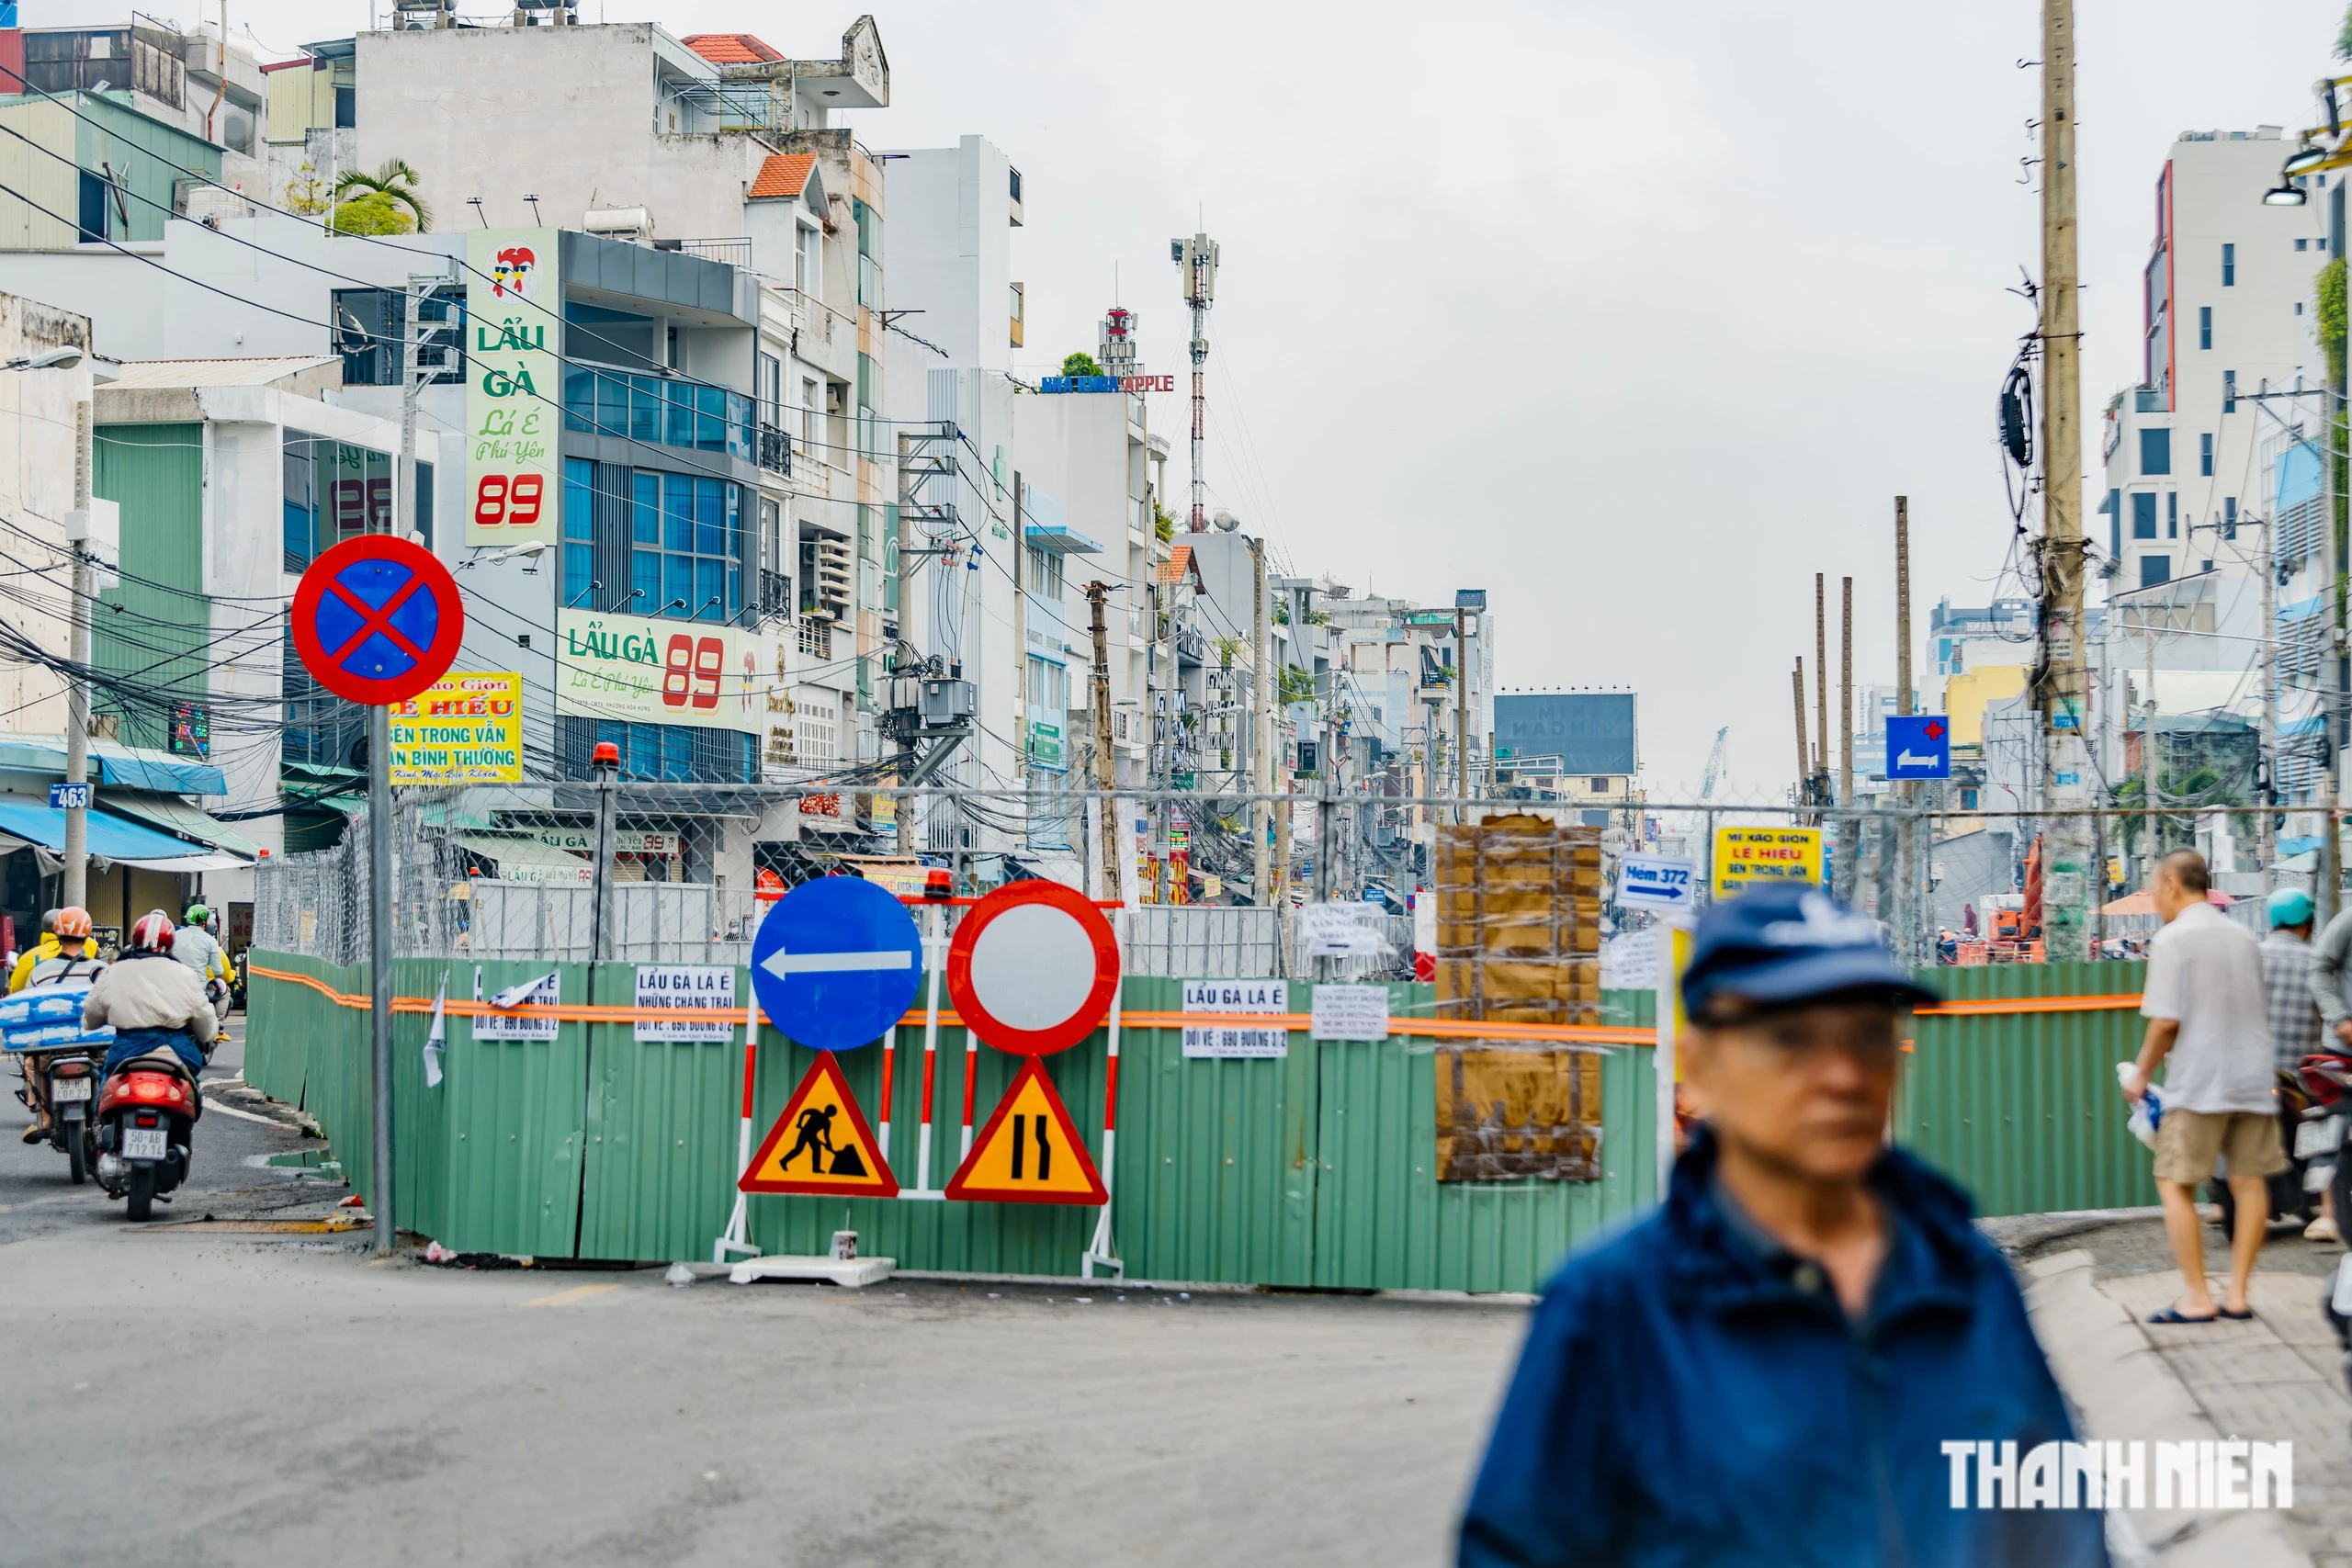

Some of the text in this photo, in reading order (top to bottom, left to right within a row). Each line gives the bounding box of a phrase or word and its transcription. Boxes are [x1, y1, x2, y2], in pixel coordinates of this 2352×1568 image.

[477, 317, 544, 353] LẨU
[482, 361, 537, 399] GÀ
[1124, 375, 1173, 392] APPLE
[479, 406, 541, 436] Lá É
[475, 440, 545, 464] Phú Yên
[474, 473, 544, 528] 89
[569, 621, 617, 660] LẨU
[623, 627, 659, 664] GÀ
[662, 633, 724, 710] 89
[460, 679, 509, 691] Giòn
[571, 667, 654, 699] Lá É Phú Yên
[429, 693, 514, 719] HIẾU
[1158, 692, 1186, 713] GM
[420, 728, 470, 743] TRONG
[475, 719, 506, 743] VẪN
[412, 746, 448, 766] BÌNH
[453, 745, 515, 766] THƯỜNG
[58, 787, 87, 807] 463
[540, 830, 588, 847] ẨU GÀ
[1660, 868, 1689, 885] 372
[1750, 863, 1784, 876] TRONG
[639, 967, 729, 990] LẨU GÀ LÁ É
[639, 992, 732, 1010] NHỮNG CHÀNG TRAI
[1187, 982, 1283, 1005] LẨU GÀ LÁ É
[504, 1016, 517, 1031] 690
[1222, 1031, 1238, 1047] 690
[60, 1079, 84, 1089] 59-H1
[131, 1131, 162, 1142] 50-AB
[128, 1143, 164, 1156] 712.14
